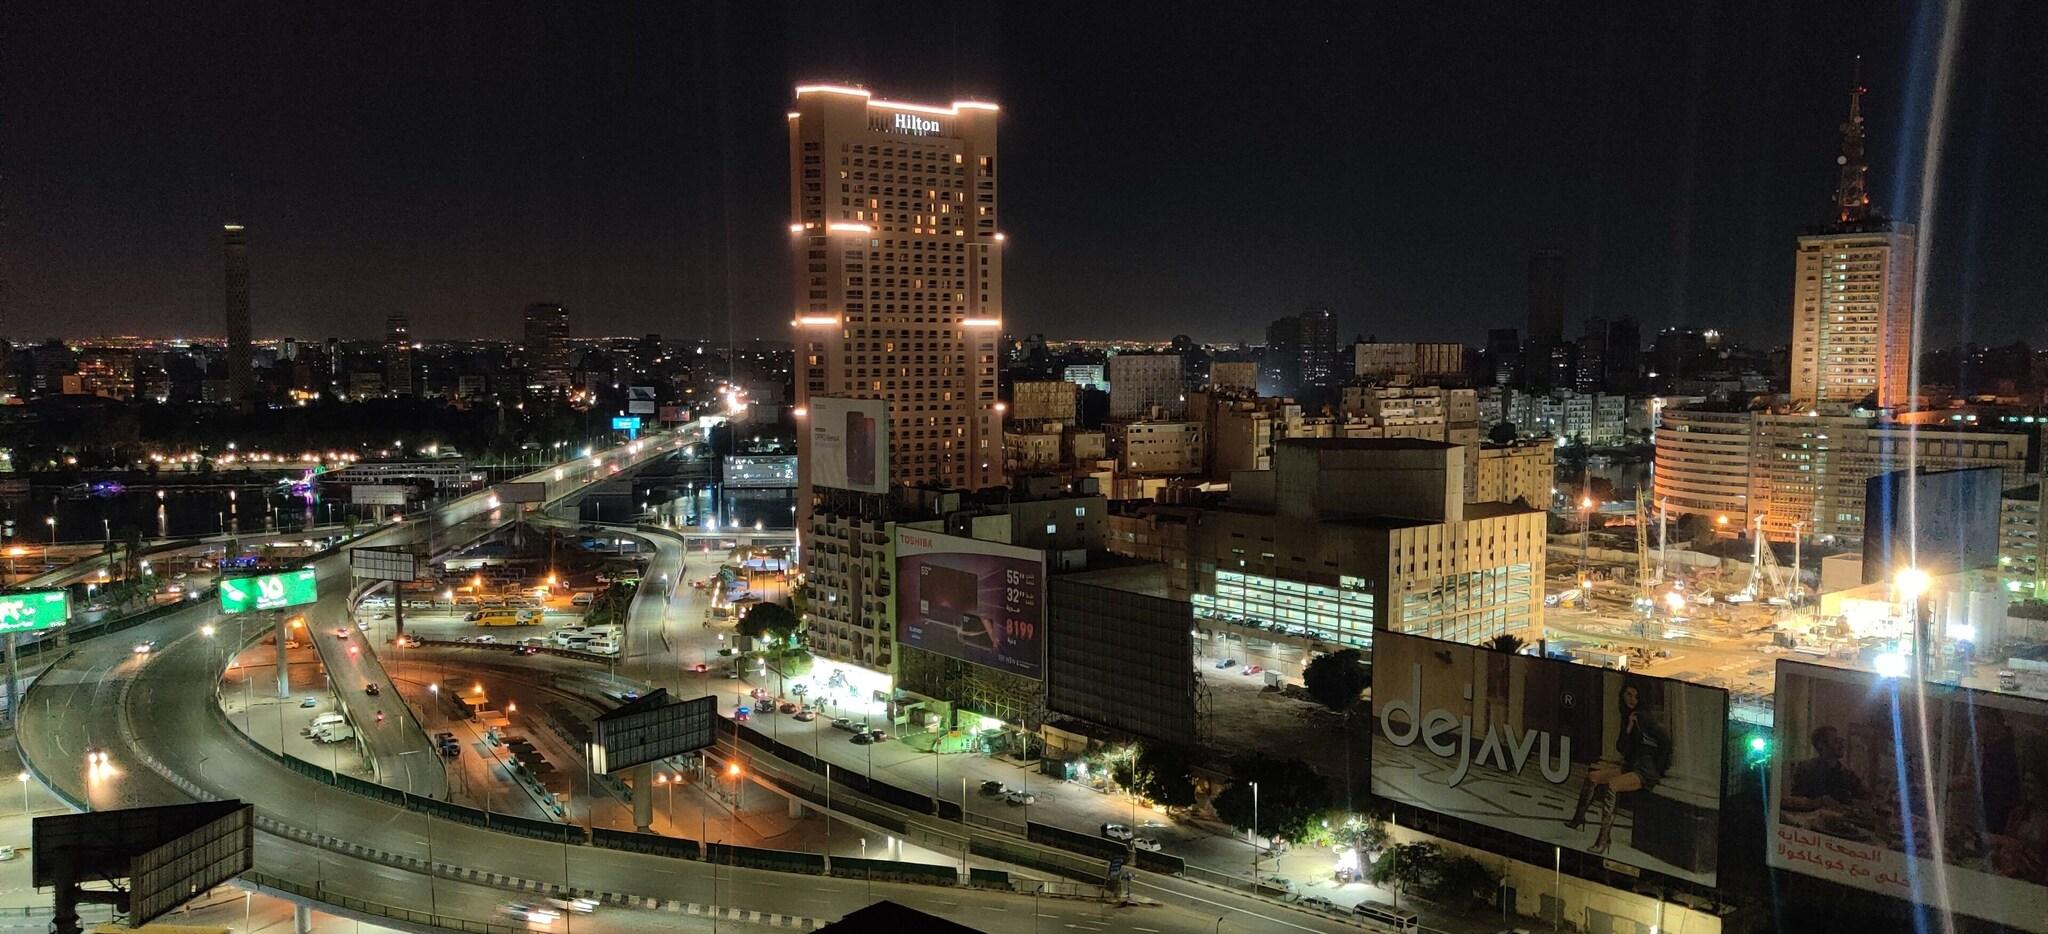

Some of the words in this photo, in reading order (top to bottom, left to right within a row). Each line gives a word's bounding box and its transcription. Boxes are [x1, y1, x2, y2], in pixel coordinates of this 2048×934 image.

[895, 113, 940, 132] Hilton
[900, 534, 933, 549] TOSHIBA
[1006, 619, 1034, 640] 8199
[1777, 843, 1845, 871] كوكاكولا
[1849, 863, 1870, 877] مع
